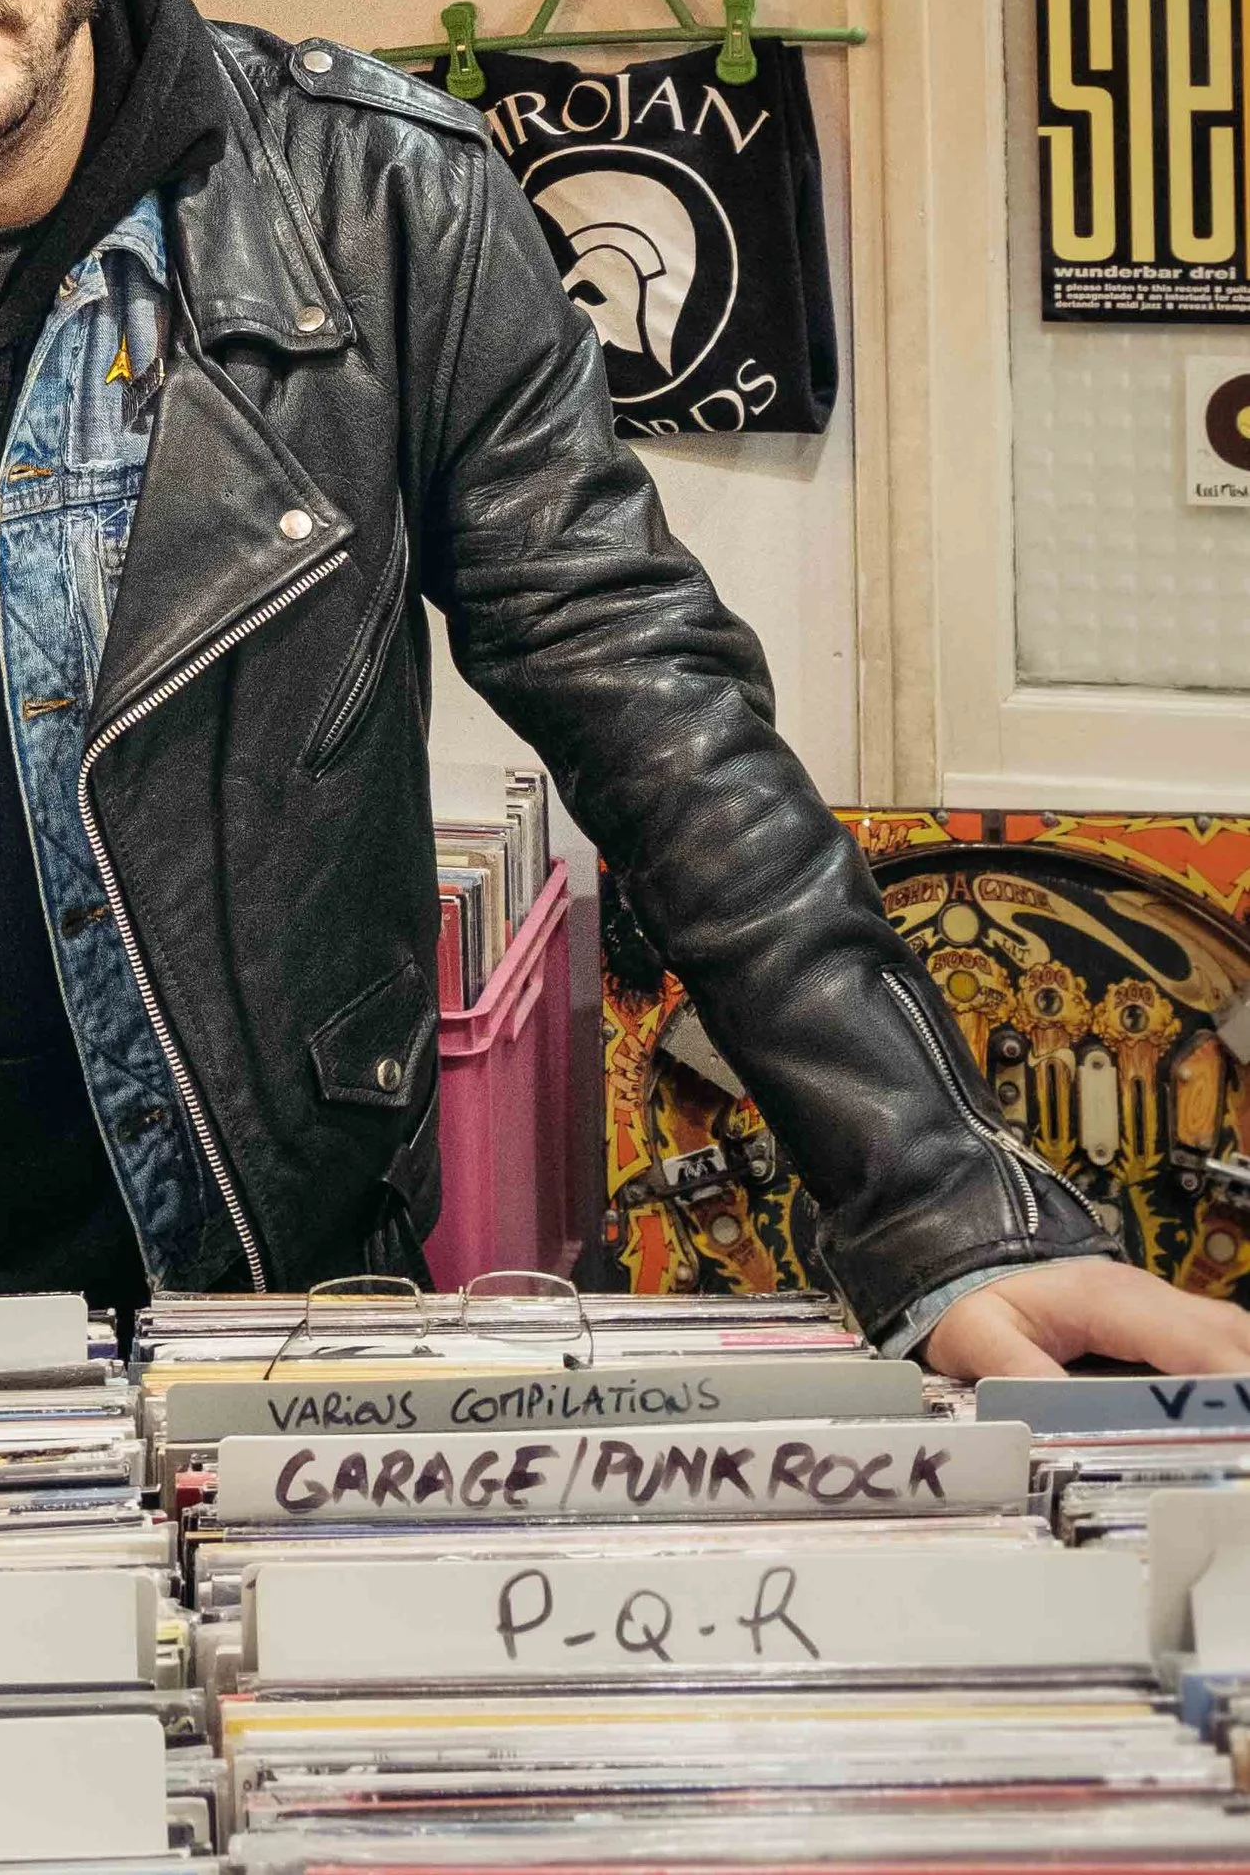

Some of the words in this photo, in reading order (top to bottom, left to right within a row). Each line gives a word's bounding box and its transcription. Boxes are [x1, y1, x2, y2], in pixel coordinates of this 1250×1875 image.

[1054, 265, 1183, 279] wunderbar
[1189, 266, 1237, 280] drei
[1065, 283, 1102, 294] please
[1137, 283, 1149, 293] to
[1151, 283, 1172, 293] this
